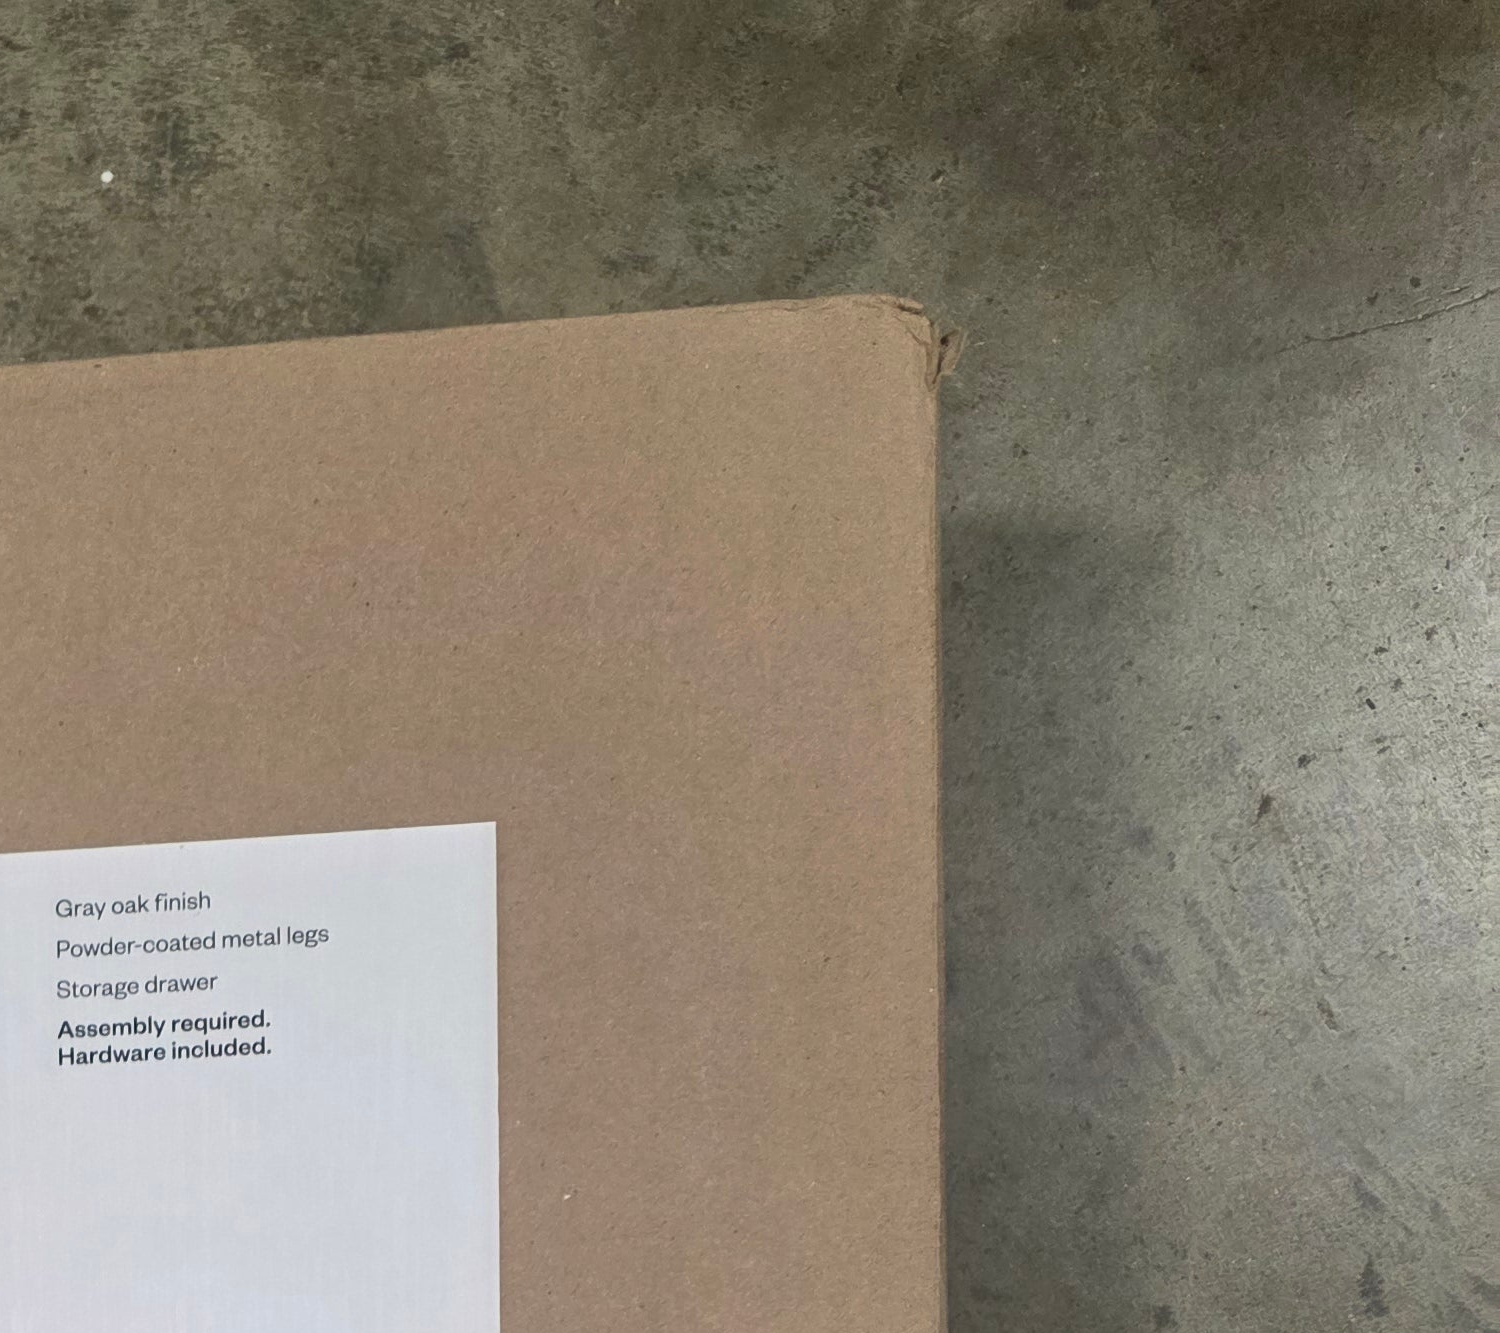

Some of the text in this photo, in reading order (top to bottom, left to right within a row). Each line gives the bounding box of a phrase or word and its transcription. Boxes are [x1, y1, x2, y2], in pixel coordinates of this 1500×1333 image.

[55, 890, 212, 921] Gray oak finish
[56, 925, 330, 958] Powder-coated metal legs
[56, 974, 219, 1001] Storage drawer
[58, 1009, 272, 1040] Assembly required.
[58, 1037, 272, 1067] Hardware included.
